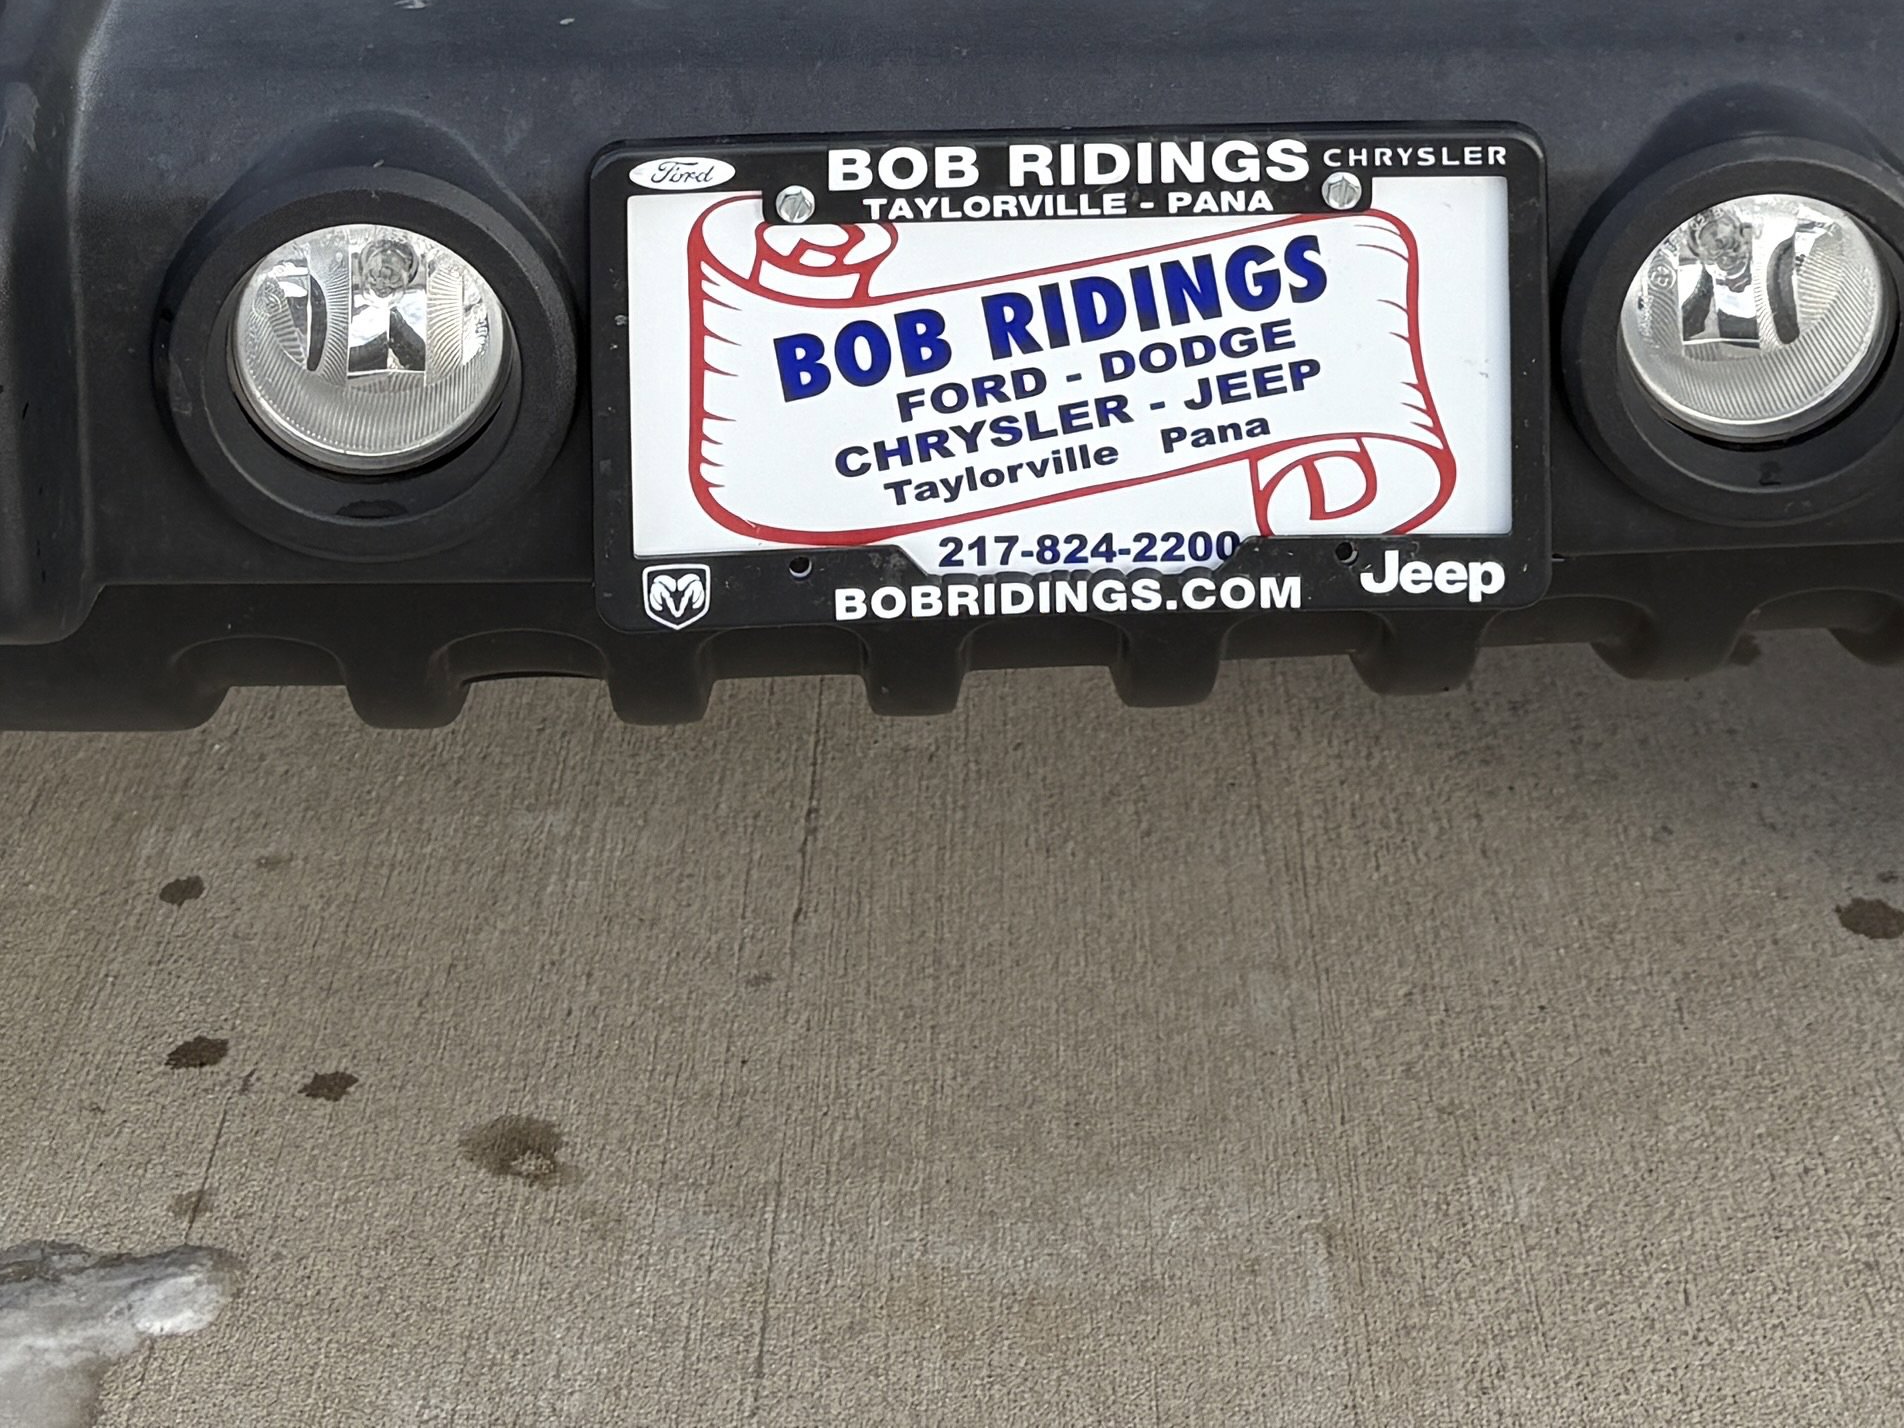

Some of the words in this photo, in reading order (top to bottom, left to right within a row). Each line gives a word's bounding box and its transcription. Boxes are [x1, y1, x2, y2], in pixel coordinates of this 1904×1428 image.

[828, 145, 980, 192] BOB
[1008, 138, 1310, 187] RIDINGS
[1323, 146, 1507, 167] CHRYSLER
[862, 192, 1127, 221] TAYLORVILLE
[1167, 189, 1274, 214] PANA
[773, 308, 952, 403] BOB
[980, 234, 1328, 361] RIDINGS
[896, 366, 1047, 423] FORD
[1099, 318, 1296, 383] DODGE
[835, 394, 1135, 478] CHRYSLER
[1183, 358, 1321, 411] JEEP
[883, 443, 1120, 506] Taylorville
[1160, 417, 1272, 454] Pana
[938, 530, 1241, 568] 217-824-2200
[1359, 549, 1506, 603] Jeep
[834, 576, 1302, 621] BOBRIDINGS.COM
